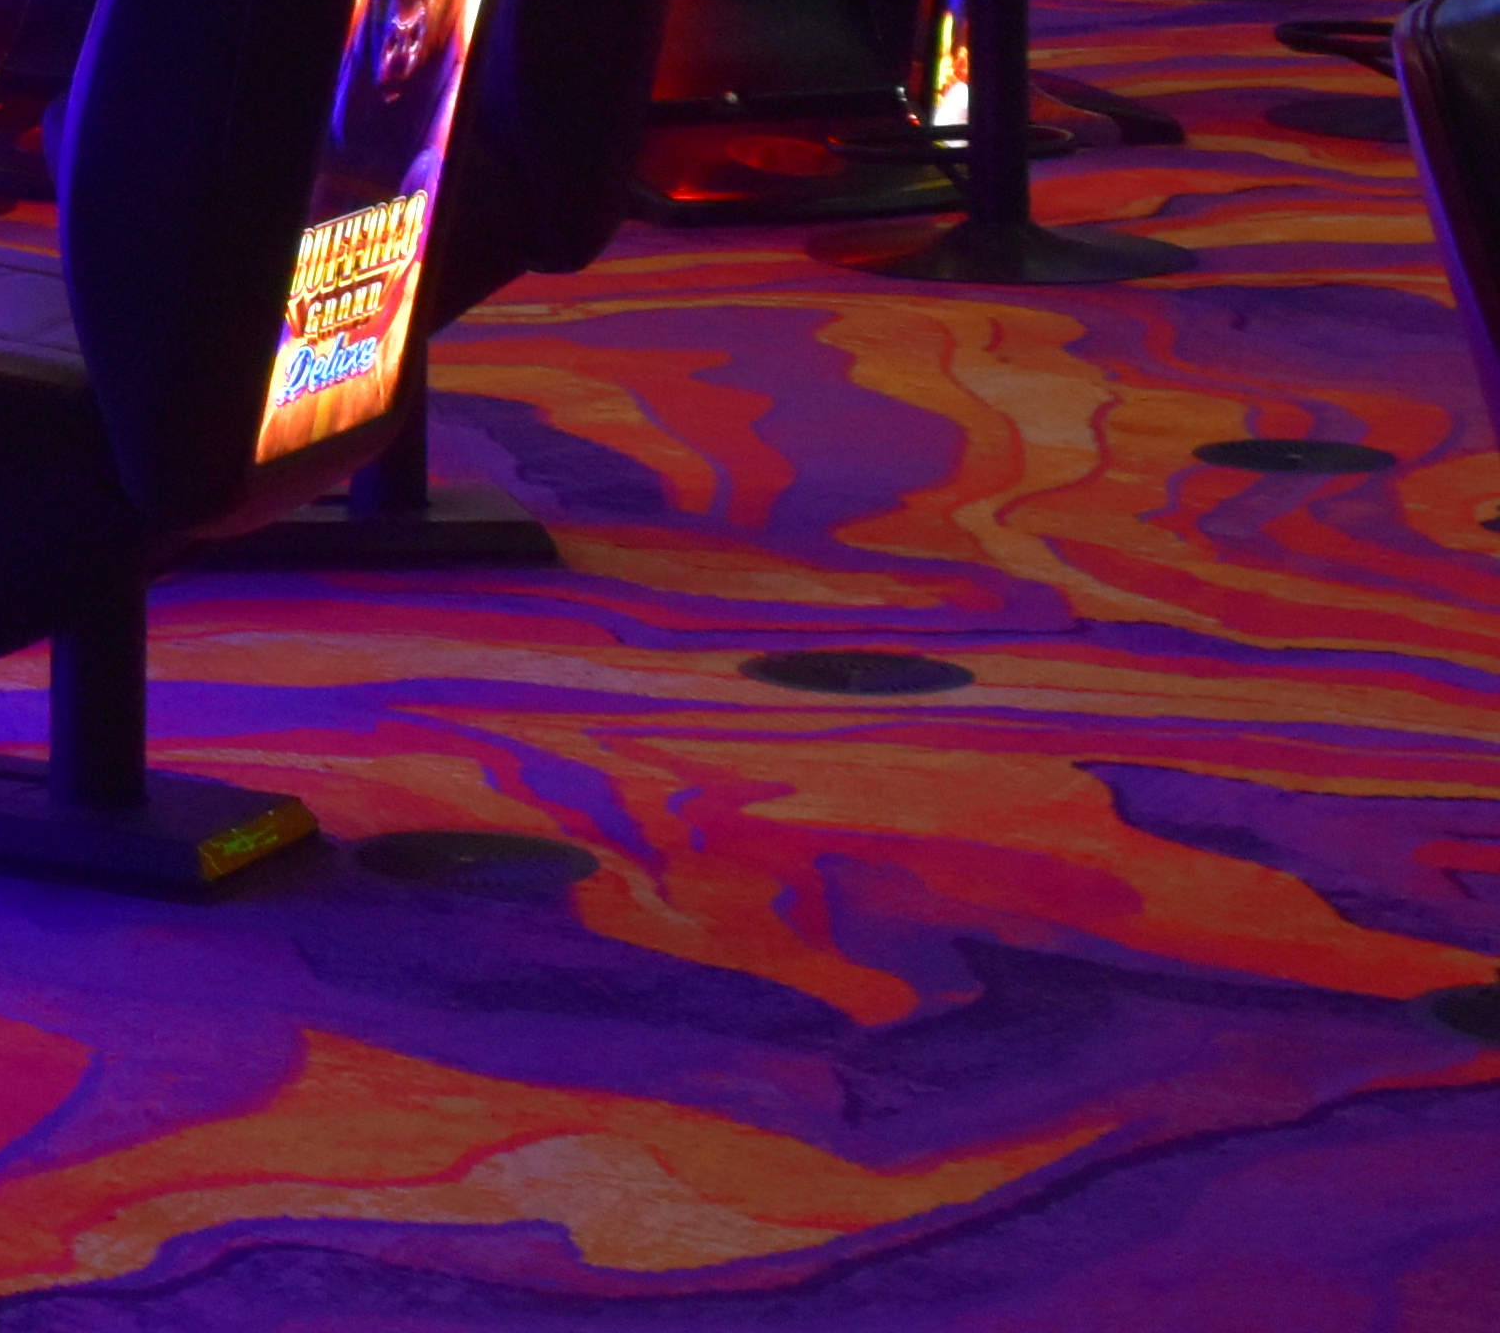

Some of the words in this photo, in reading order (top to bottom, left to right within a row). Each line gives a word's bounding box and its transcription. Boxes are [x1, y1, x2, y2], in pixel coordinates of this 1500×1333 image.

[289, 190, 428, 301] BUFFALO
[305, 281, 382, 335] GRAND
[275, 332, 377, 406] Deluxe
